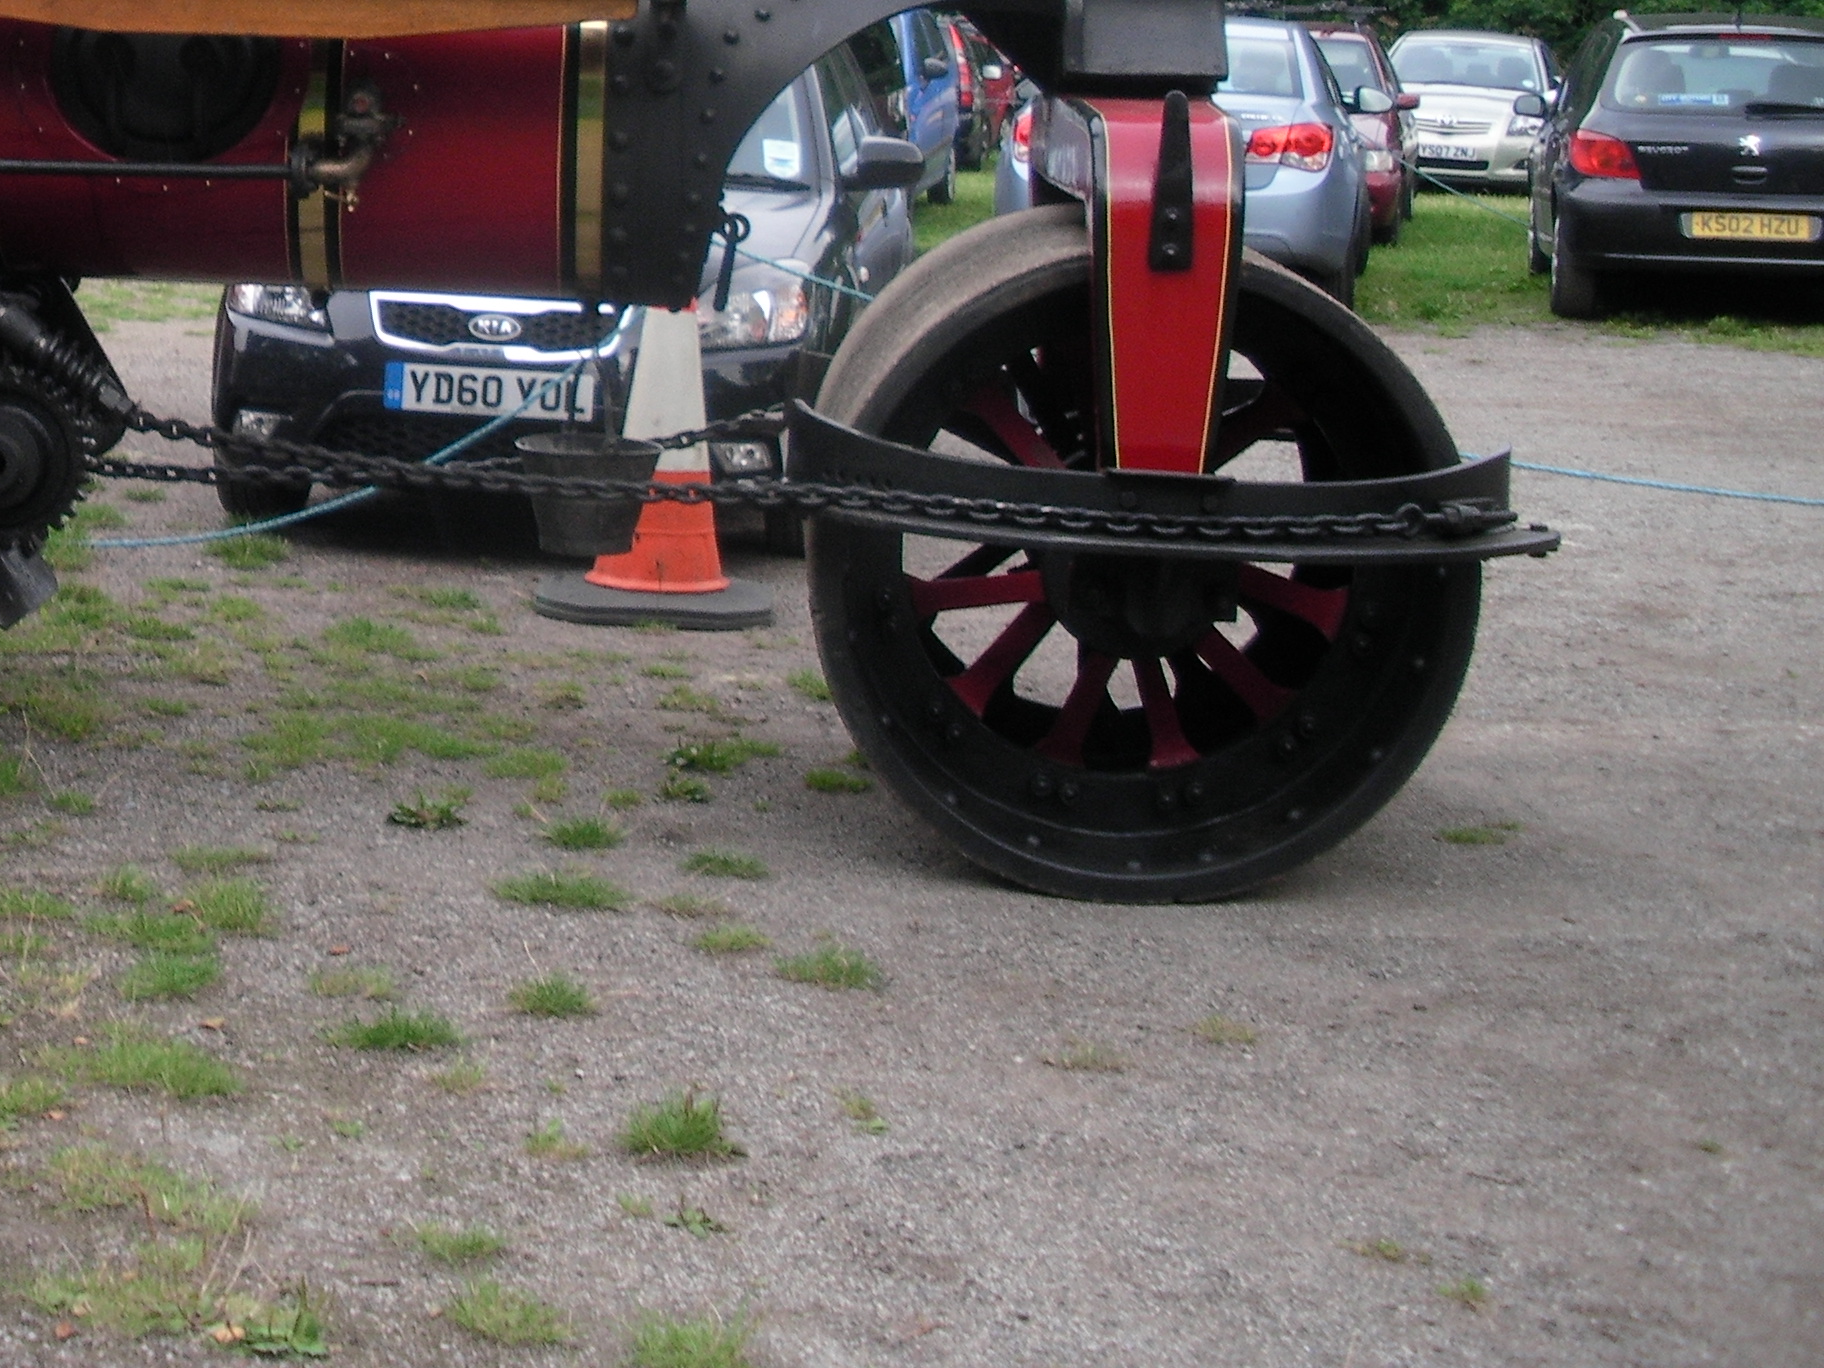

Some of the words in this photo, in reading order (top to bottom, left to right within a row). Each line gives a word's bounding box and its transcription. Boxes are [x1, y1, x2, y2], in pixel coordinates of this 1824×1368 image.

[1420, 143, 1451, 157] YS07
[1453, 145, 1476, 159] ZNJ
[1698, 214, 1754, 234] KS02
[1758, 216, 1800, 236] HZU
[477, 318, 513, 335] KIA
[410, 369, 503, 408] YD60
